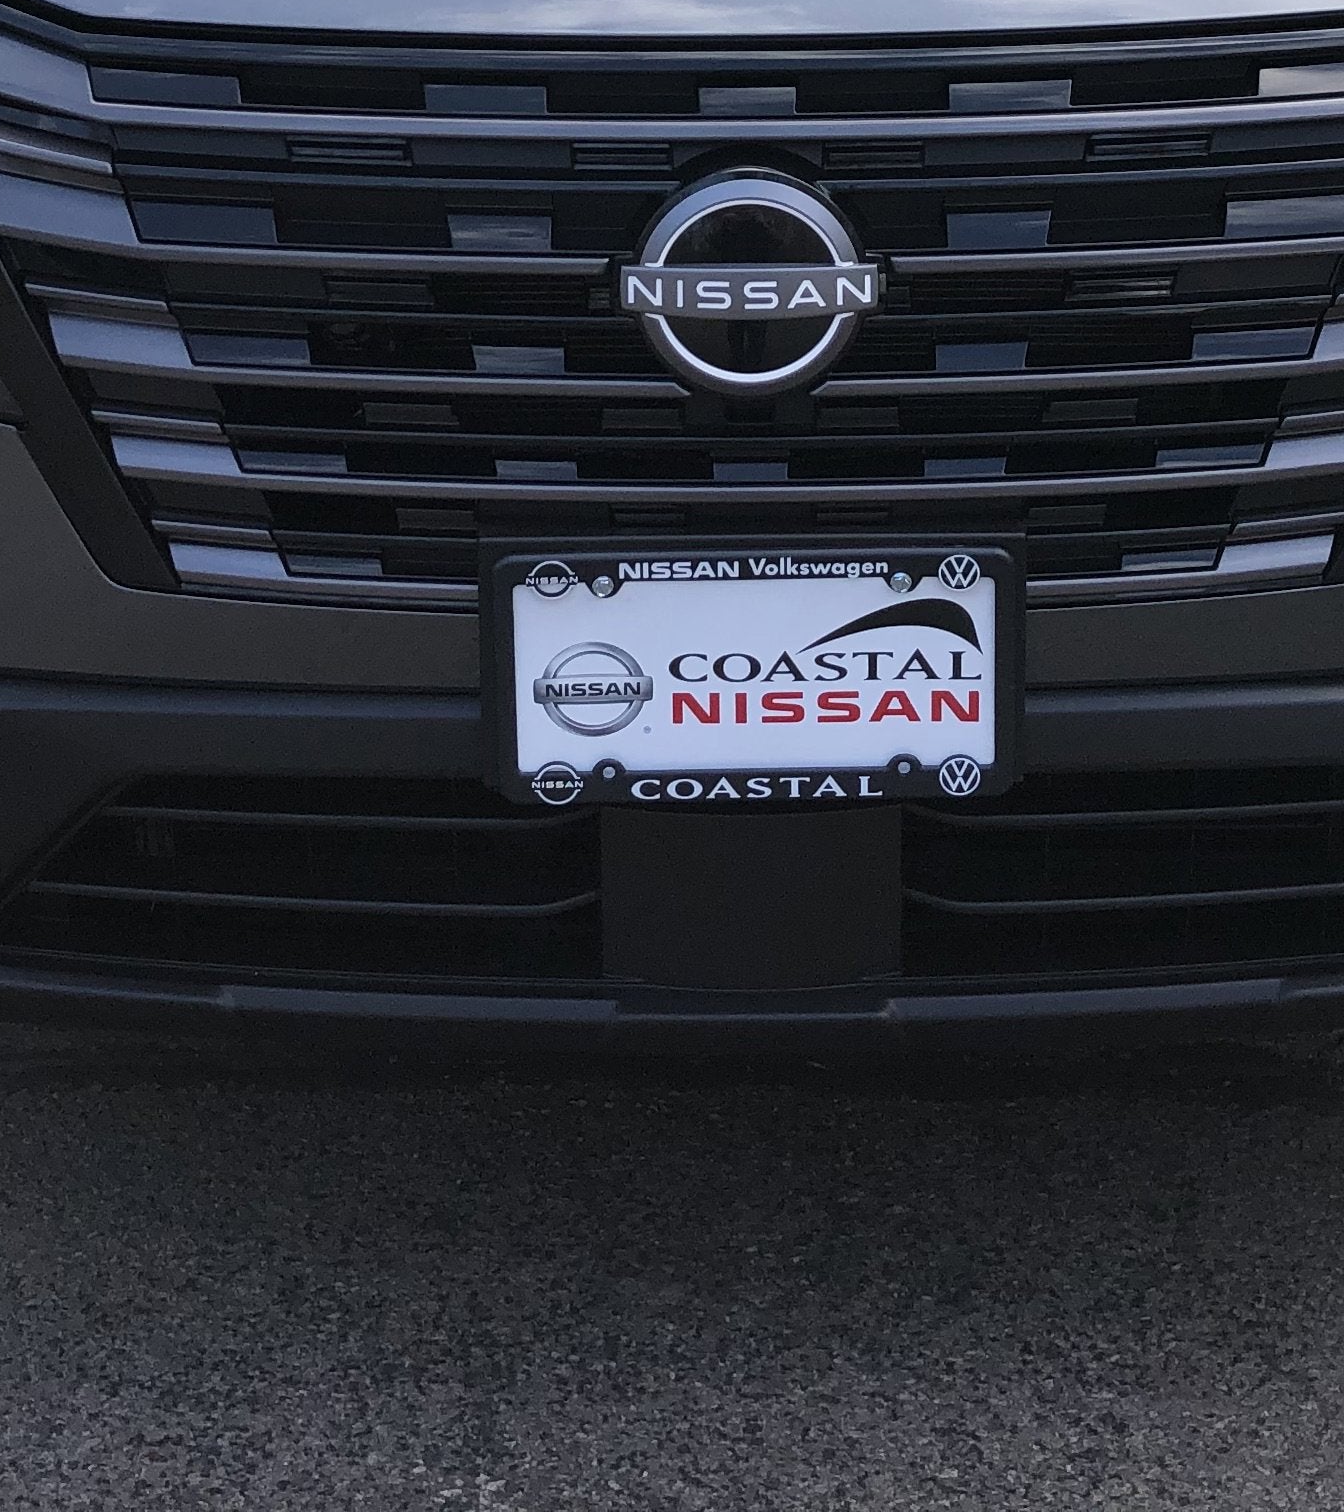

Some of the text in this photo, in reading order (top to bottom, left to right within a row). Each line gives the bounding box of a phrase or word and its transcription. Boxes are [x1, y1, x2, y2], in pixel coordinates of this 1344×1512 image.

[626, 273, 872, 310] NISSAN
[525, 575, 579, 585] NISSAN
[618, 557, 890, 581] NISSAN Volkswagen
[668, 647, 983, 683] COASTAL
[544, 680, 642, 698] NISSAN
[671, 689, 980, 725] NISSAN
[531, 780, 584, 789] NISSAN
[630, 774, 884, 801] COASTAL
